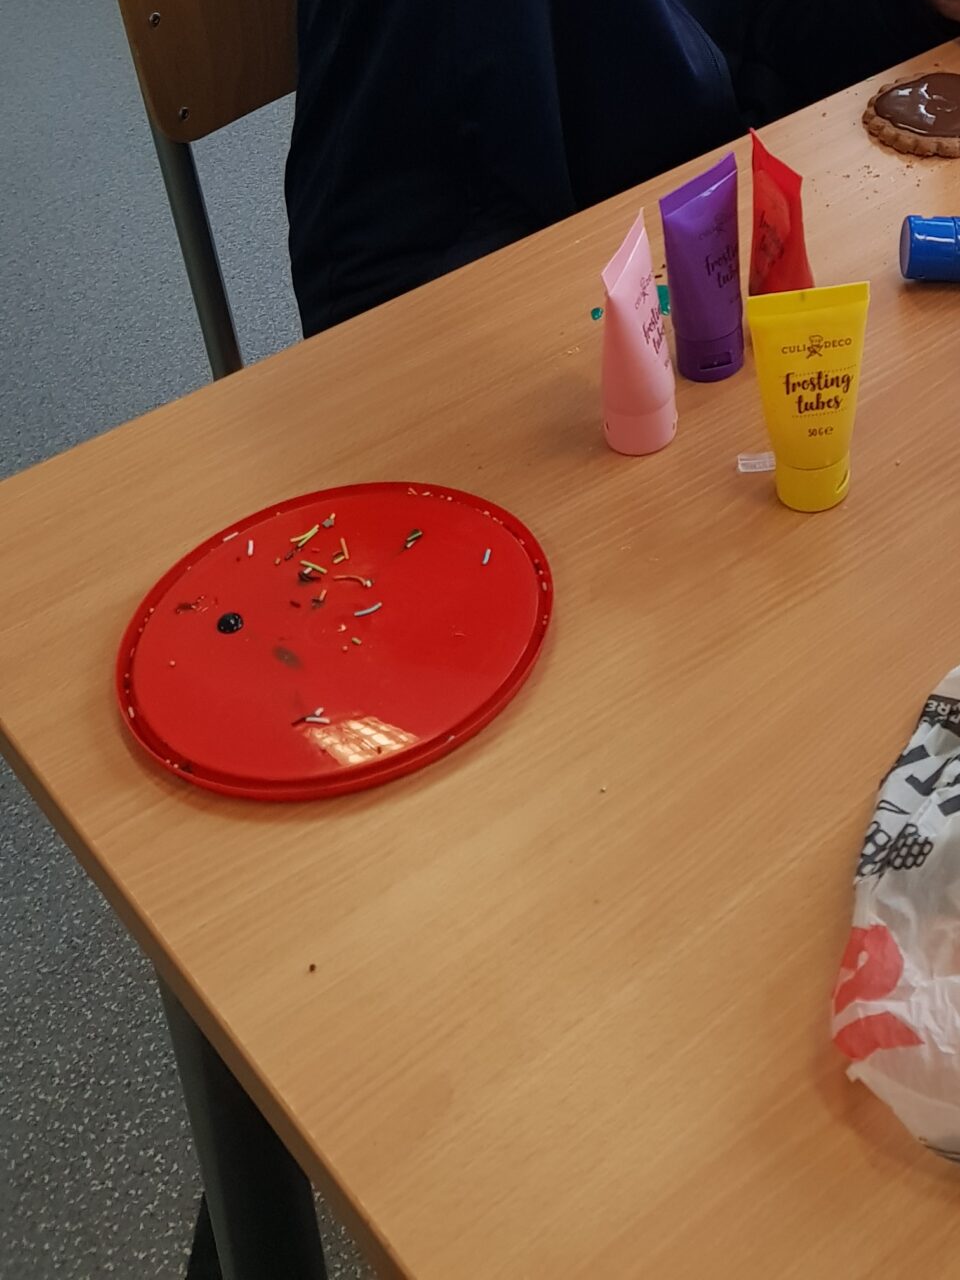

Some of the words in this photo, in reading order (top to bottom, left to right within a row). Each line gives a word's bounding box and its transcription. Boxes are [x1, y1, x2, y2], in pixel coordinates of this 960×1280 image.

[781, 344, 806, 355] CULI
[824, 338, 852, 348] DECO
[796, 393, 844, 414] tubes
